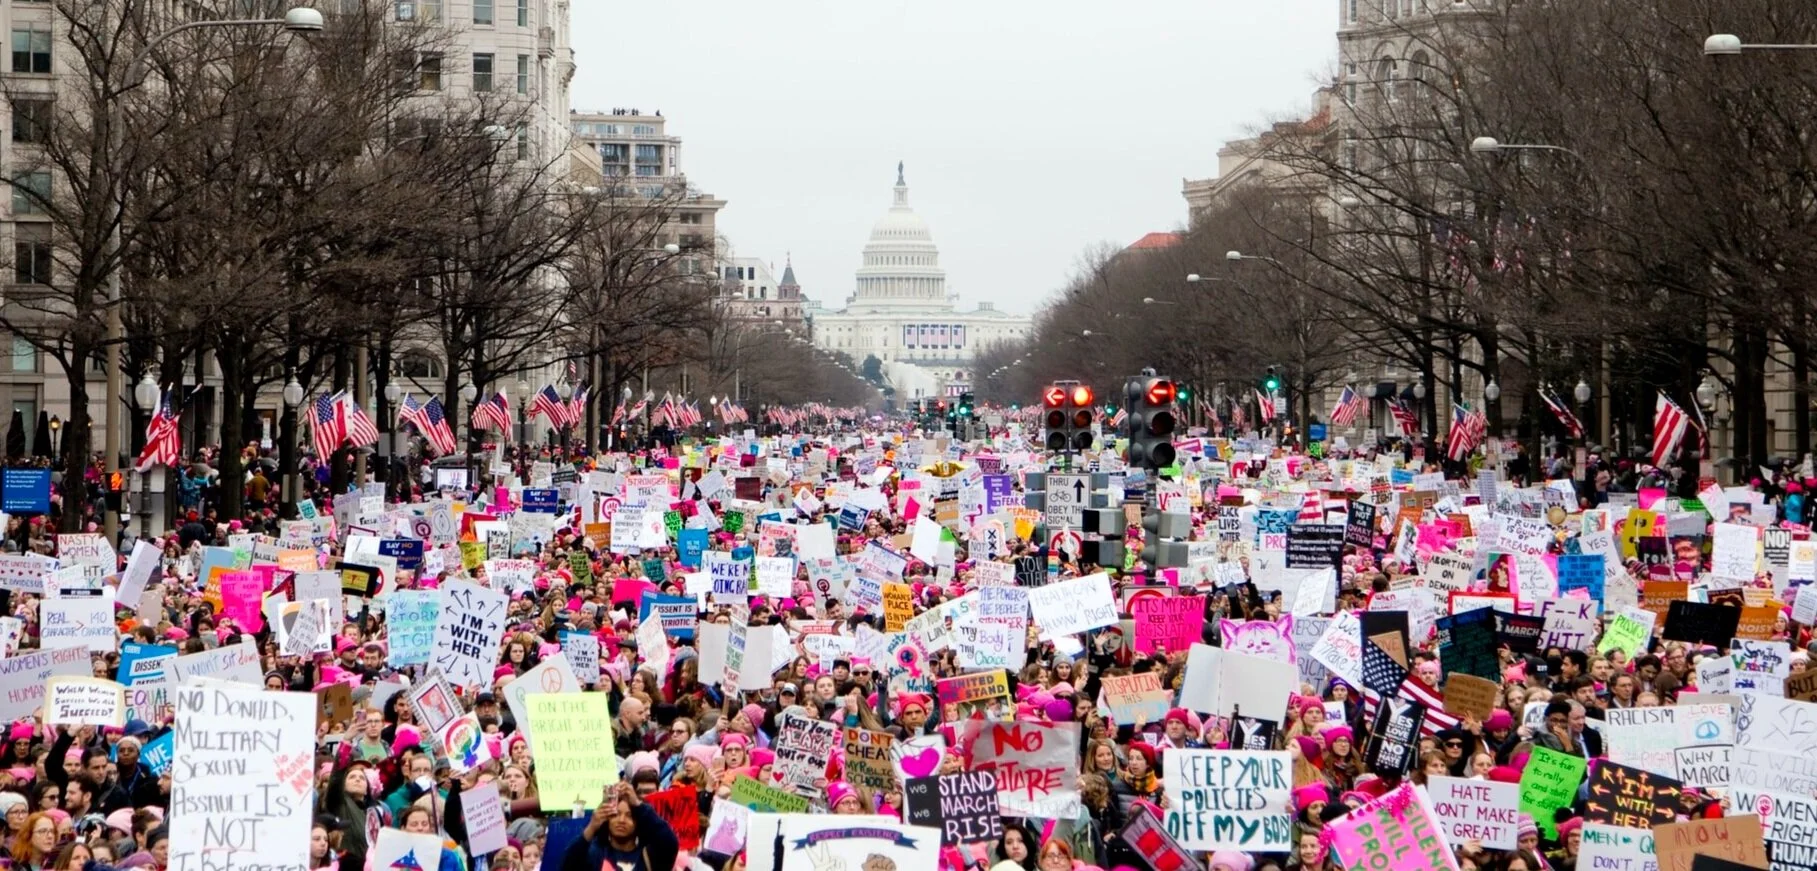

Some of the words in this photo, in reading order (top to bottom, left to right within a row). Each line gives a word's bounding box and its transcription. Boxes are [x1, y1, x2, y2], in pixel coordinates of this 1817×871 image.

[1049, 477, 1069, 487] THRU
[1048, 505, 1068, 514] OBEY
[1218, 506, 1240, 518] BLACK
[1355, 510, 1370, 520] NOT
[1047, 515, 1075, 525] SIGNAL
[1218, 519, 1240, 531] LIVES
[1506, 517, 1549, 531] TRUMP
[60, 535, 97, 546] NASTY
[1218, 532, 1241, 542] MATTER
[1506, 525, 1514, 534] IS
[1515, 528, 1546, 539] GUILTY
[1764, 530, 1790, 548] NO!
[1499, 537, 1542, 556] TREASON
[1587, 536, 1609, 550] YES
[60, 547, 100, 558] WOMEN
[711, 562, 739, 577] WE'RE
[1430, 555, 1473, 571] ABORTION
[1441, 569, 1455, 580] ON
[979, 586, 997, 600] THE
[997, 588, 1021, 601] POWER
[1428, 580, 1460, 592] DEMAND
[684, 605, 692, 613] IS
[887, 600, 909, 611] PLACE
[979, 602, 996, 615] THE
[995, 603, 1020, 615] PEOPLE
[1161, 597, 1180, 612] MY
[1180, 596, 1205, 612] BODY
[1541, 602, 1593, 619] F--K
[47, 612, 69, 625] REAL
[90, 611, 108, 624] 140
[390, 611, 440, 624] STORM
[461, 612, 484, 630] I'M
[1084, 603, 1116, 625] RIGHT
[1504, 624, 1540, 637] MARCH
[1552, 618, 1573, 631] this
[1736, 624, 1774, 632] NOISY
[390, 633, 434, 648] LIGH
[450, 623, 489, 648] WITH
[959, 624, 977, 641] my
[979, 630, 1004, 652] Body
[51, 646, 91, 665] RIGHTS
[451, 639, 481, 660] HER
[222, 651, 236, 668] sit
[574, 655, 593, 664] WITH
[951, 674, 995, 690] UNITED
[1103, 674, 1161, 696] DISPUTIN
[8, 682, 46, 703] HUMAN
[56, 685, 85, 697] WHEN
[124, 689, 169, 707] EQUAL
[965, 684, 1006, 700] STAND
[1122, 694, 1143, 704] THIS
[538, 700, 557, 713] ON
[560, 700, 589, 713] THE
[1386, 698, 1414, 729] YES
[1689, 703, 1727, 718] LOVE
[531, 717, 573, 733] BRIGHT
[578, 717, 605, 732] SIDE
[784, 714, 808, 731] KEEP
[809, 720, 833, 738] YOUR
[1608, 709, 1675, 727] RACISM
[176, 717, 282, 756] MILITARY
[781, 728, 831, 754] LAWS
[848, 731, 893, 747] DON'T
[992, 724, 1044, 757] NO
[1237, 718, 1267, 747] YES
[1387, 726, 1410, 740] LOVE
[543, 738, 562, 753] NO
[567, 737, 601, 752] MORE
[1381, 741, 1405, 755] NO
[142, 744, 174, 769] WE
[777, 748, 796, 761] OUT
[807, 756, 827, 770] OUR
[1378, 753, 1401, 768] HATE
[1538, 752, 1557, 767] It's
[1558, 757, 1576, 771] fun
[1681, 750, 1714, 765] WHY
[1724, 749, 1730, 763] I
[1740, 748, 1758, 767] I
[1767, 755, 1817, 778] WILL
[174, 756, 258, 782] SEXUAL
[1179, 754, 1233, 788] KEEP
[1235, 757, 1288, 790] YOUR
[1533, 766, 1544, 777] to
[1544, 772, 1565, 787] rally
[1682, 767, 1731, 786] MARCH
[290, 768, 314, 796] NO
[846, 774, 894, 790] SCHOOLS
[909, 783, 928, 795] we
[938, 769, 997, 796] STAND
[1619, 778, 1654, 798] I'M
[1734, 768, 1758, 786] NO
[1764, 773, 1817, 796] LONGER
[737, 785, 772, 806] CANNOT
[743, 777, 763, 794] OUR
[766, 786, 807, 809] CLIMATE
[1182, 787, 1267, 812] POLICIES
[1450, 784, 1492, 802] HATE
[1522, 791, 1536, 804] for
[1530, 782, 1548, 794] and
[1548, 788, 1571, 801] stuff
[172, 788, 249, 818] ASSAULT
[256, 783, 293, 818] IS
[913, 807, 931, 819] we
[939, 794, 1000, 819] MARCH
[1615, 795, 1655, 816] WITH
[468, 811, 482, 823] NOW
[481, 803, 499, 817] LET'S
[1476, 806, 1517, 825] MAKE
[1612, 812, 1650, 829] HER
[203, 817, 265, 851] NOT
[469, 819, 504, 839] FORMATION
[808, 827, 847, 843] RESPECT
[851, 827, 900, 843] EXISTENCE
[945, 814, 1003, 842] RISE
[1168, 813, 1207, 843] OFF
[1213, 814, 1260, 845] MY
[1583, 830, 1618, 846] MEN
[1674, 826, 1728, 851] NOW
